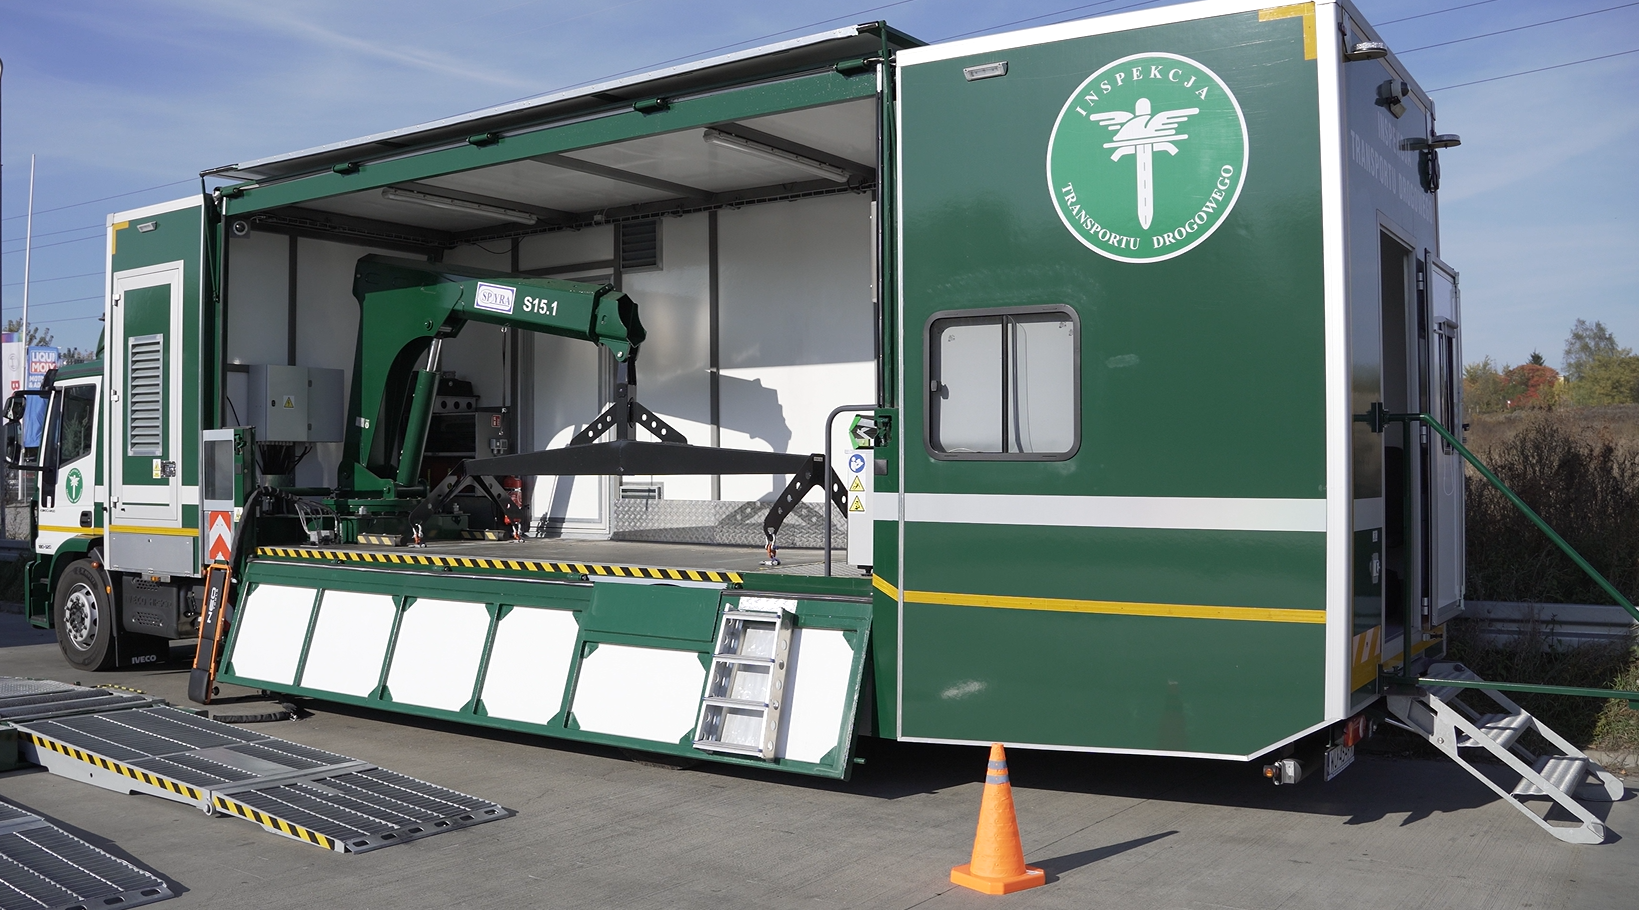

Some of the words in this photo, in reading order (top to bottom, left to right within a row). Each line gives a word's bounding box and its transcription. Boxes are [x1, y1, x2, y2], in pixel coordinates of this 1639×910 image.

[1075, 65, 1209, 117] INSPEKCJA
[1350, 129, 1397, 195] TRANSPORTU
[1061, 182, 1141, 250] TRANSPORTU
[1152, 164, 1234, 249] DROGOWEGO
[522, 296, 558, 316] S15.1
[32, 352, 56, 363] LIQUI
[131, 654, 157, 665] IVECO
